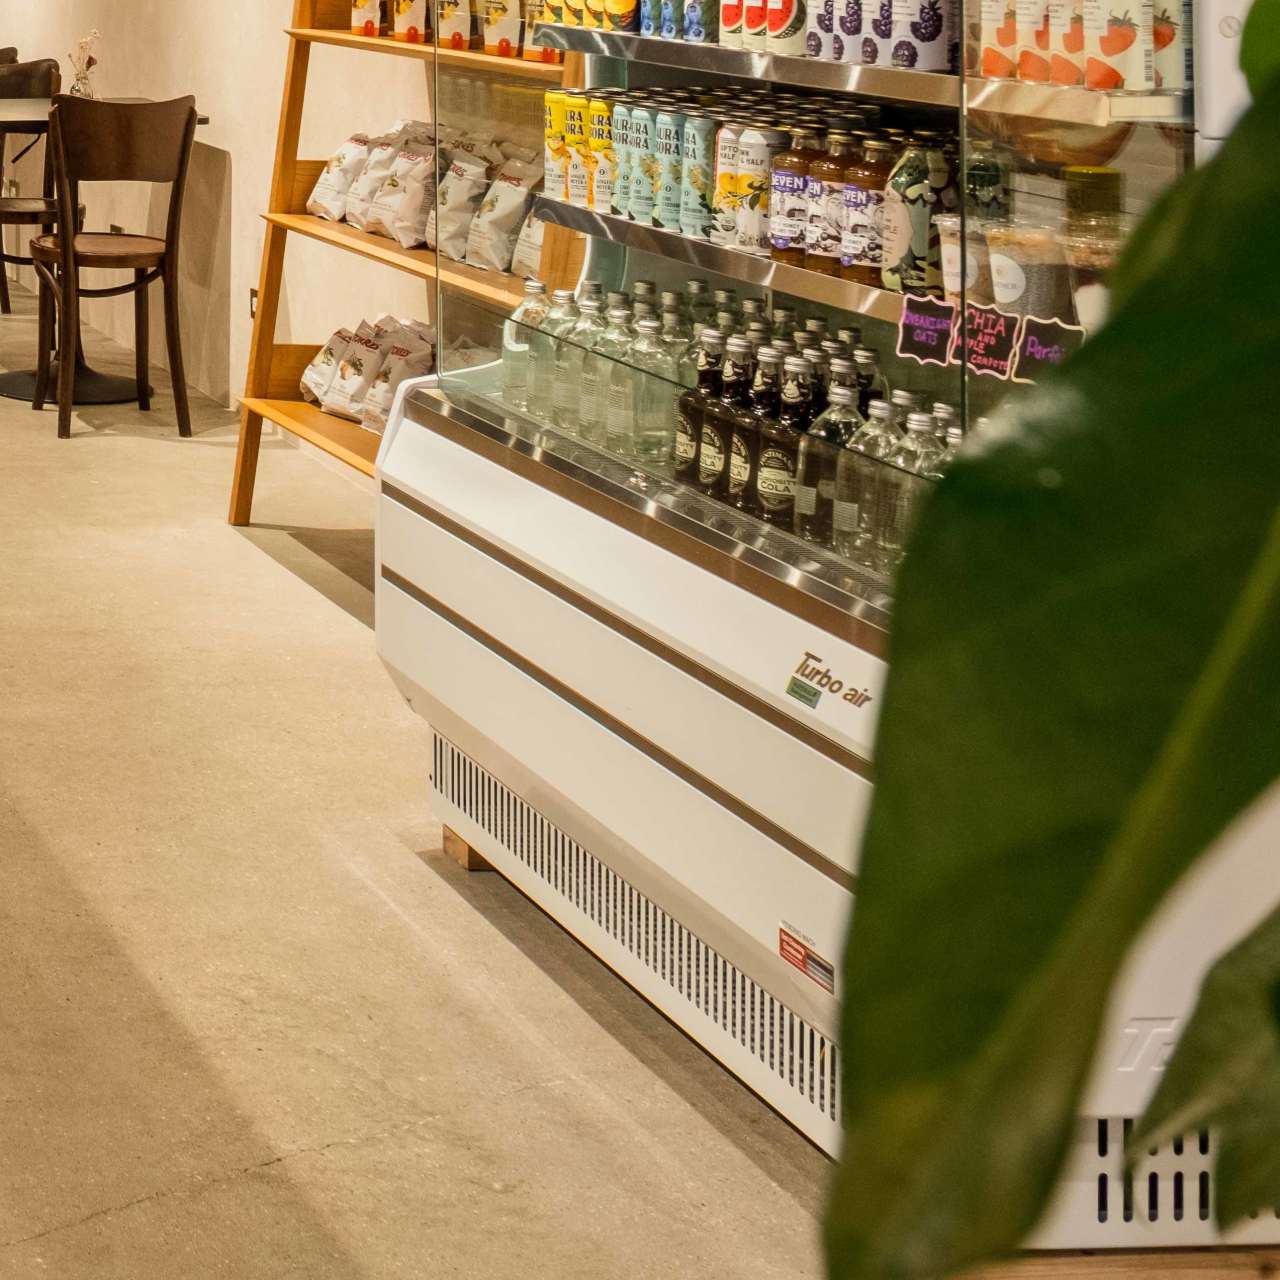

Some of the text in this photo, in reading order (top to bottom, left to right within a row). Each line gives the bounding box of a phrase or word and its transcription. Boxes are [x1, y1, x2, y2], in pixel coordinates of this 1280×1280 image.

[966, 308, 1006, 337] CHIA
[955, 335, 985, 354] APLE
[978, 334, 996, 345] AND
[760, 480, 790, 494] COLA
[795, 651, 844, 694] Turbo
[842, 687, 873, 708] air
